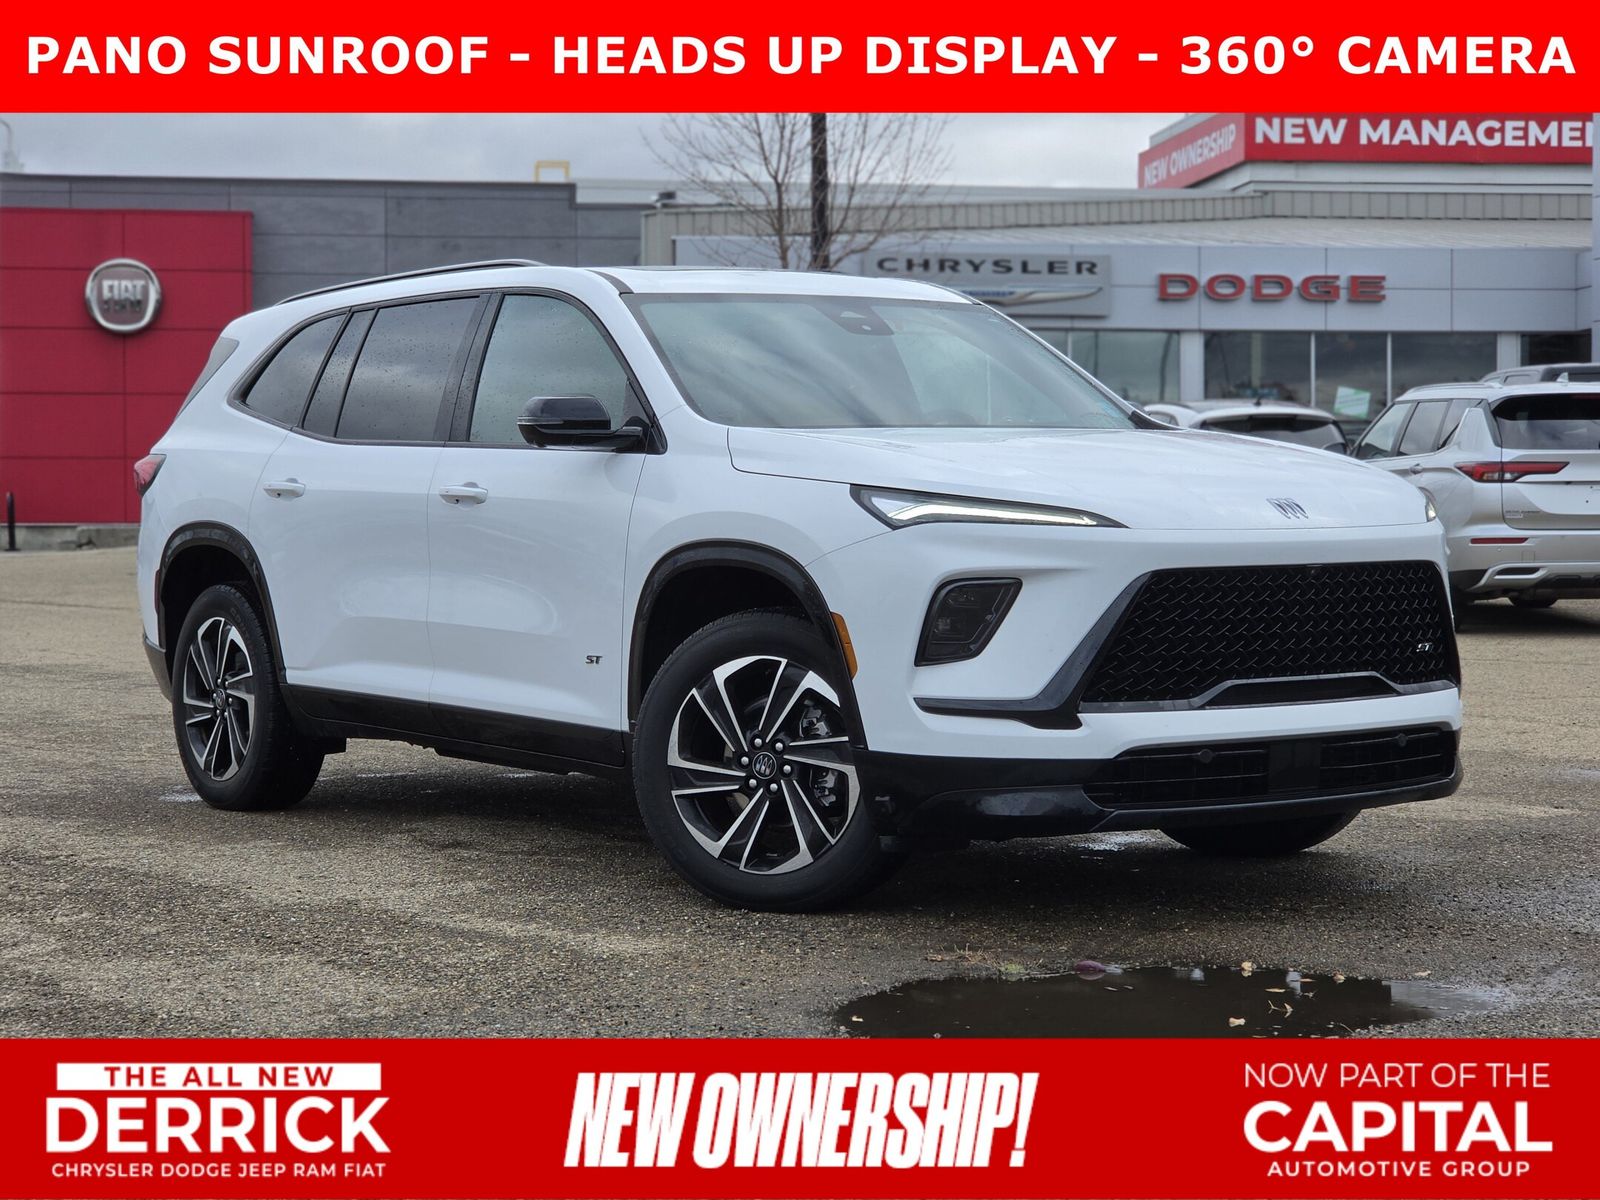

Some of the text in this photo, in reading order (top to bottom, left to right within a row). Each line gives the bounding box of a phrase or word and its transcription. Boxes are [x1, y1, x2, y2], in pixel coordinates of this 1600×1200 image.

[1255, 117, 1593, 148] NEW MANAGEME
[1144, 123, 1237, 188] NEW OWNERSHIP
[877, 257, 1099, 275] CHRYSLER
[102, 280, 145, 300] FIAT
[1157, 273, 1387, 303] DODGE
[585, 655, 603, 664] ST
